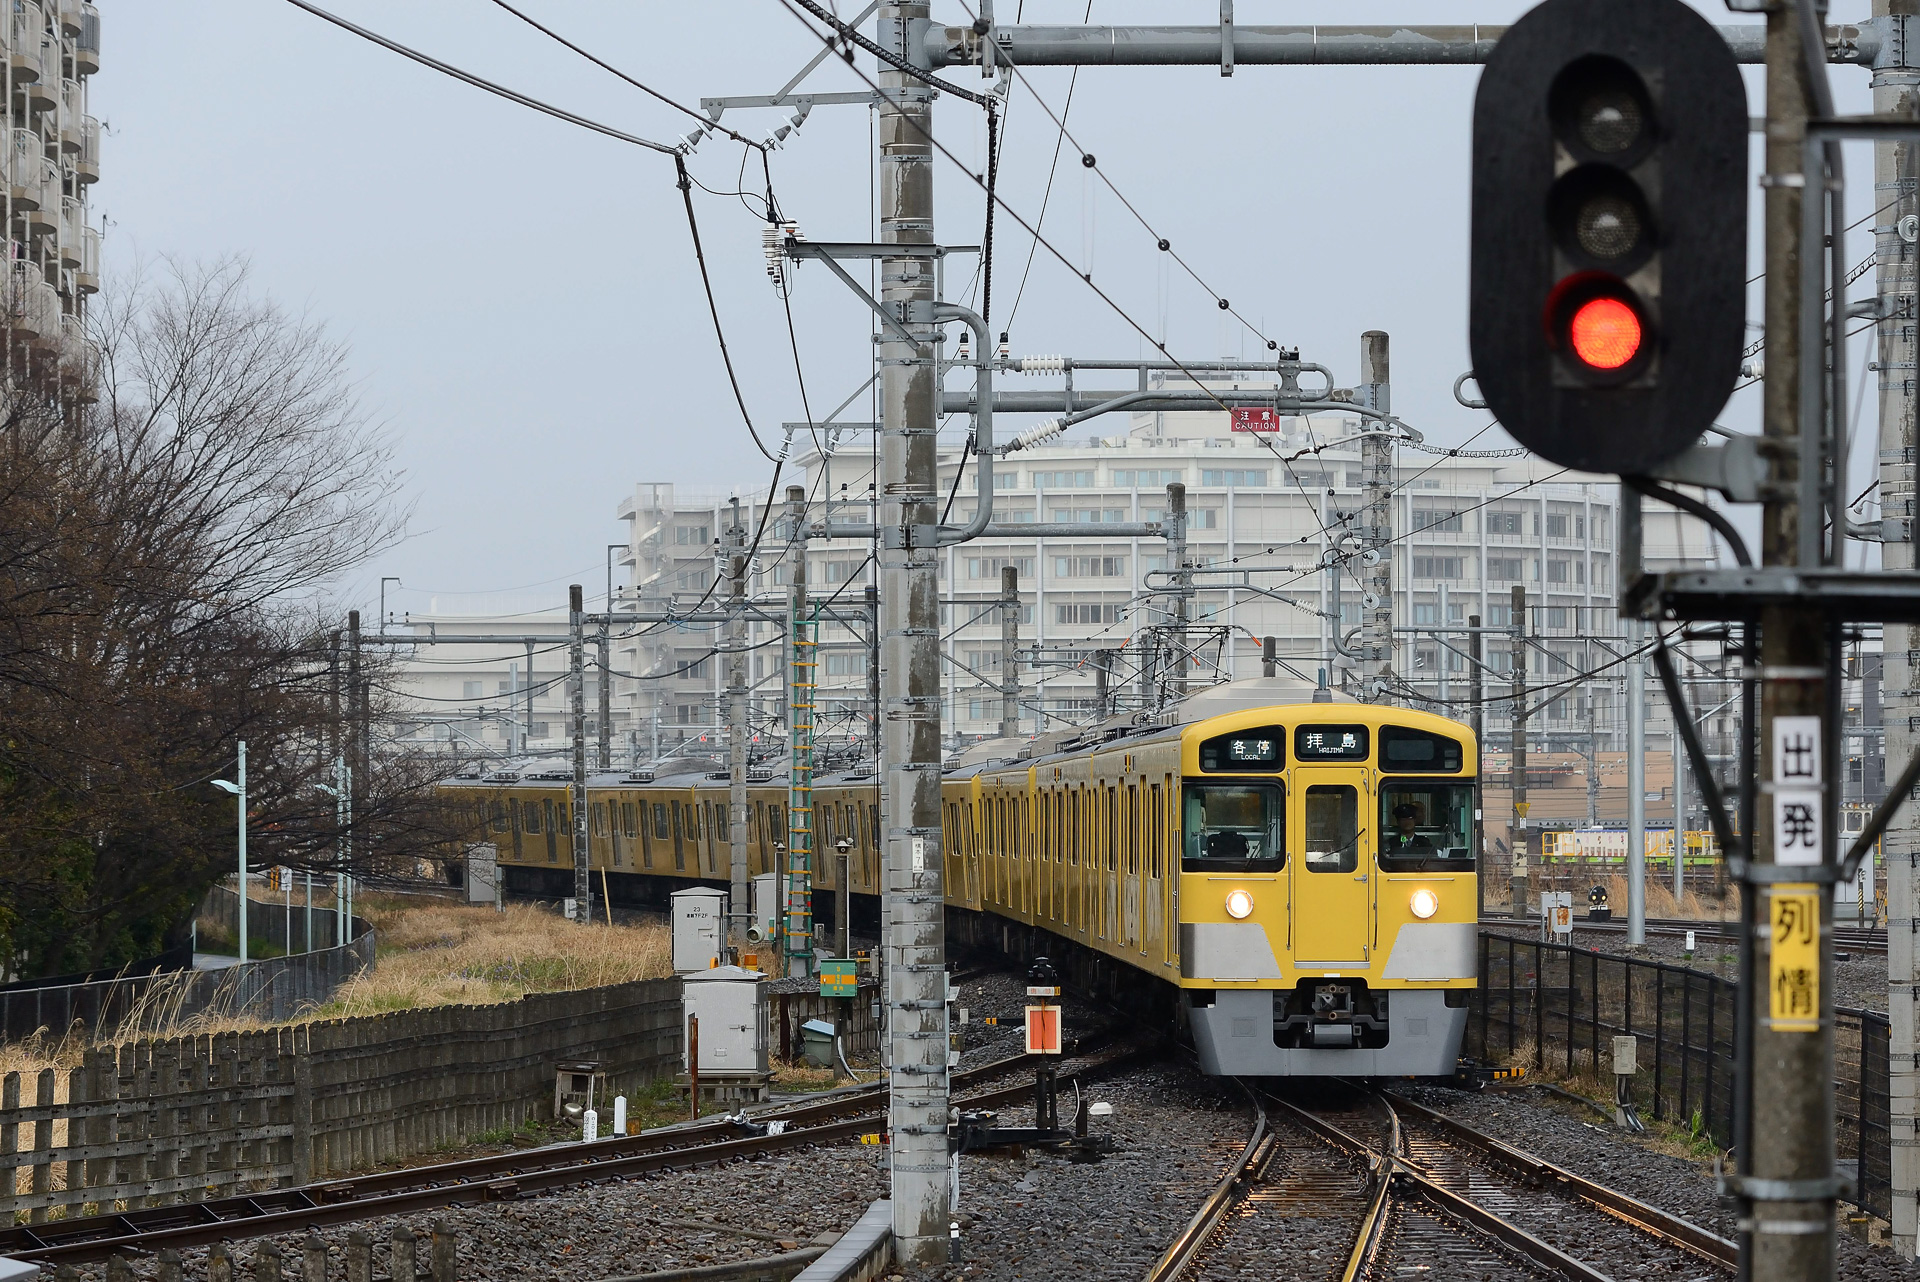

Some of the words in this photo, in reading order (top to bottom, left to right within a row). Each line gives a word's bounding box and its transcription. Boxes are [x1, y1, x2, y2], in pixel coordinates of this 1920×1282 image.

[1240, 410, 1271, 421] 注意
[1235, 422, 1276, 430] CAUTION
[1232, 739, 1271, 755] 各停
[1306, 732, 1357, 749] 拝島
[1782, 732, 1815, 850] 出発
[1774, 898, 1817, 1016] 列情
